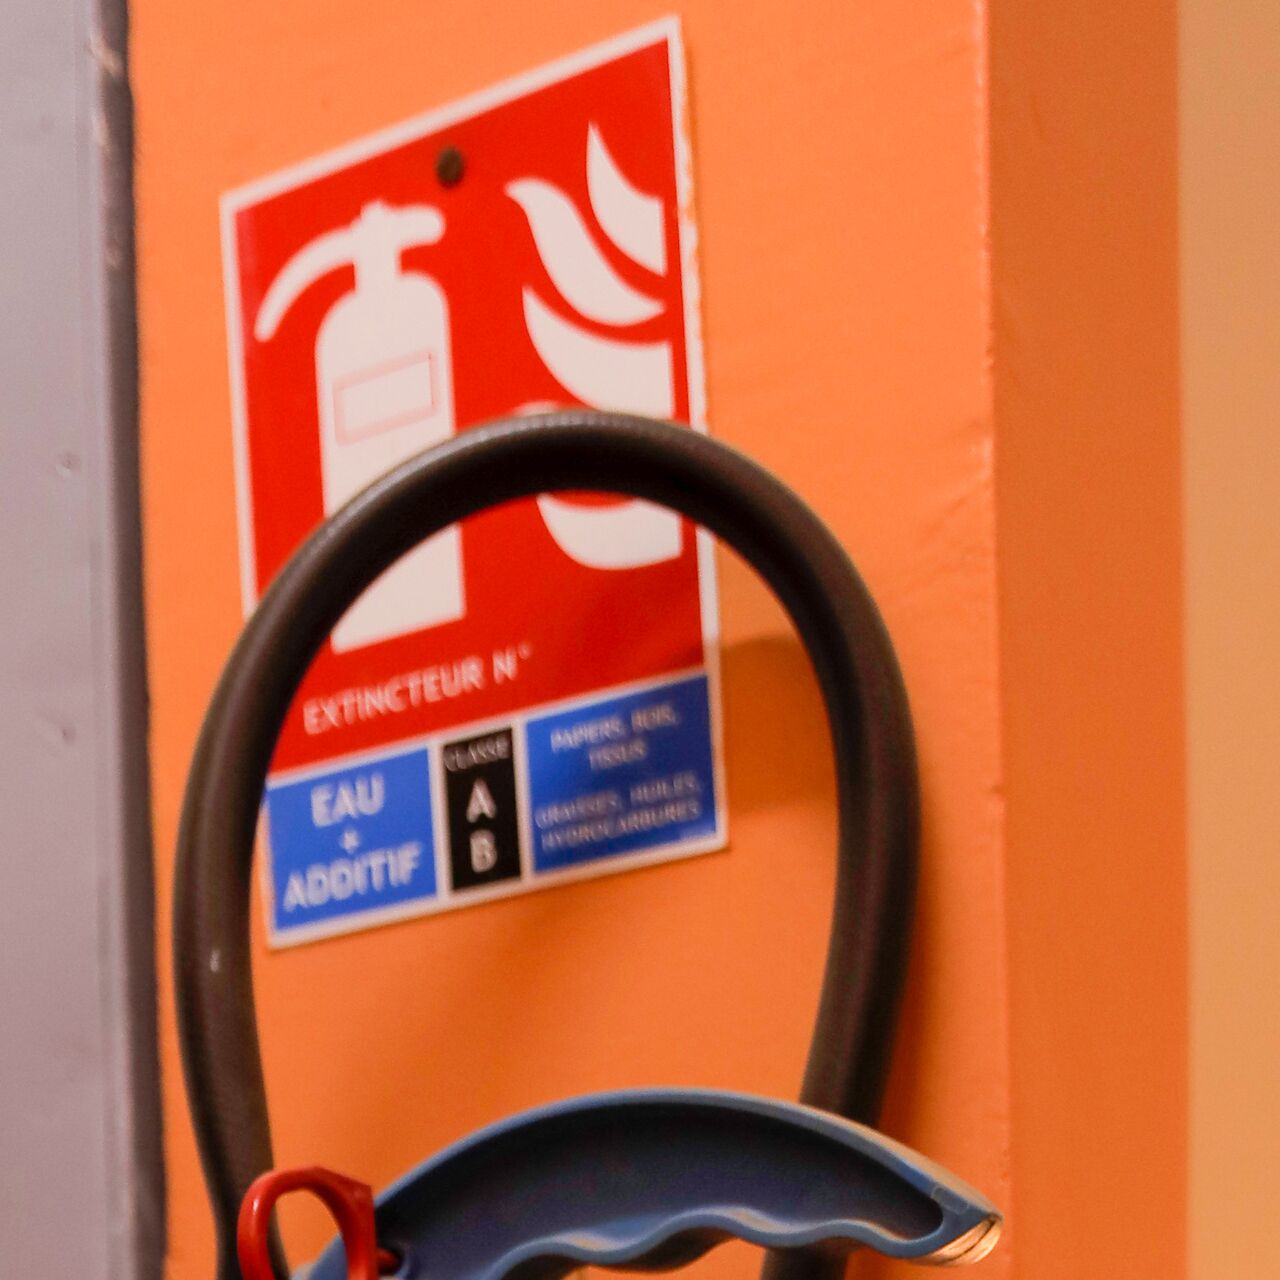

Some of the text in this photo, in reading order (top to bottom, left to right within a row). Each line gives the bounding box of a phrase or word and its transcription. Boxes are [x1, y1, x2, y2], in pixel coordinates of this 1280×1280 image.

[303, 644, 531, 736] EXTINCTEUR N°
[310, 772, 385, 828] EAU
[466, 778, 496, 823] A
[283, 841, 421, 913] ADDITIF
[470, 829, 497, 873] B
